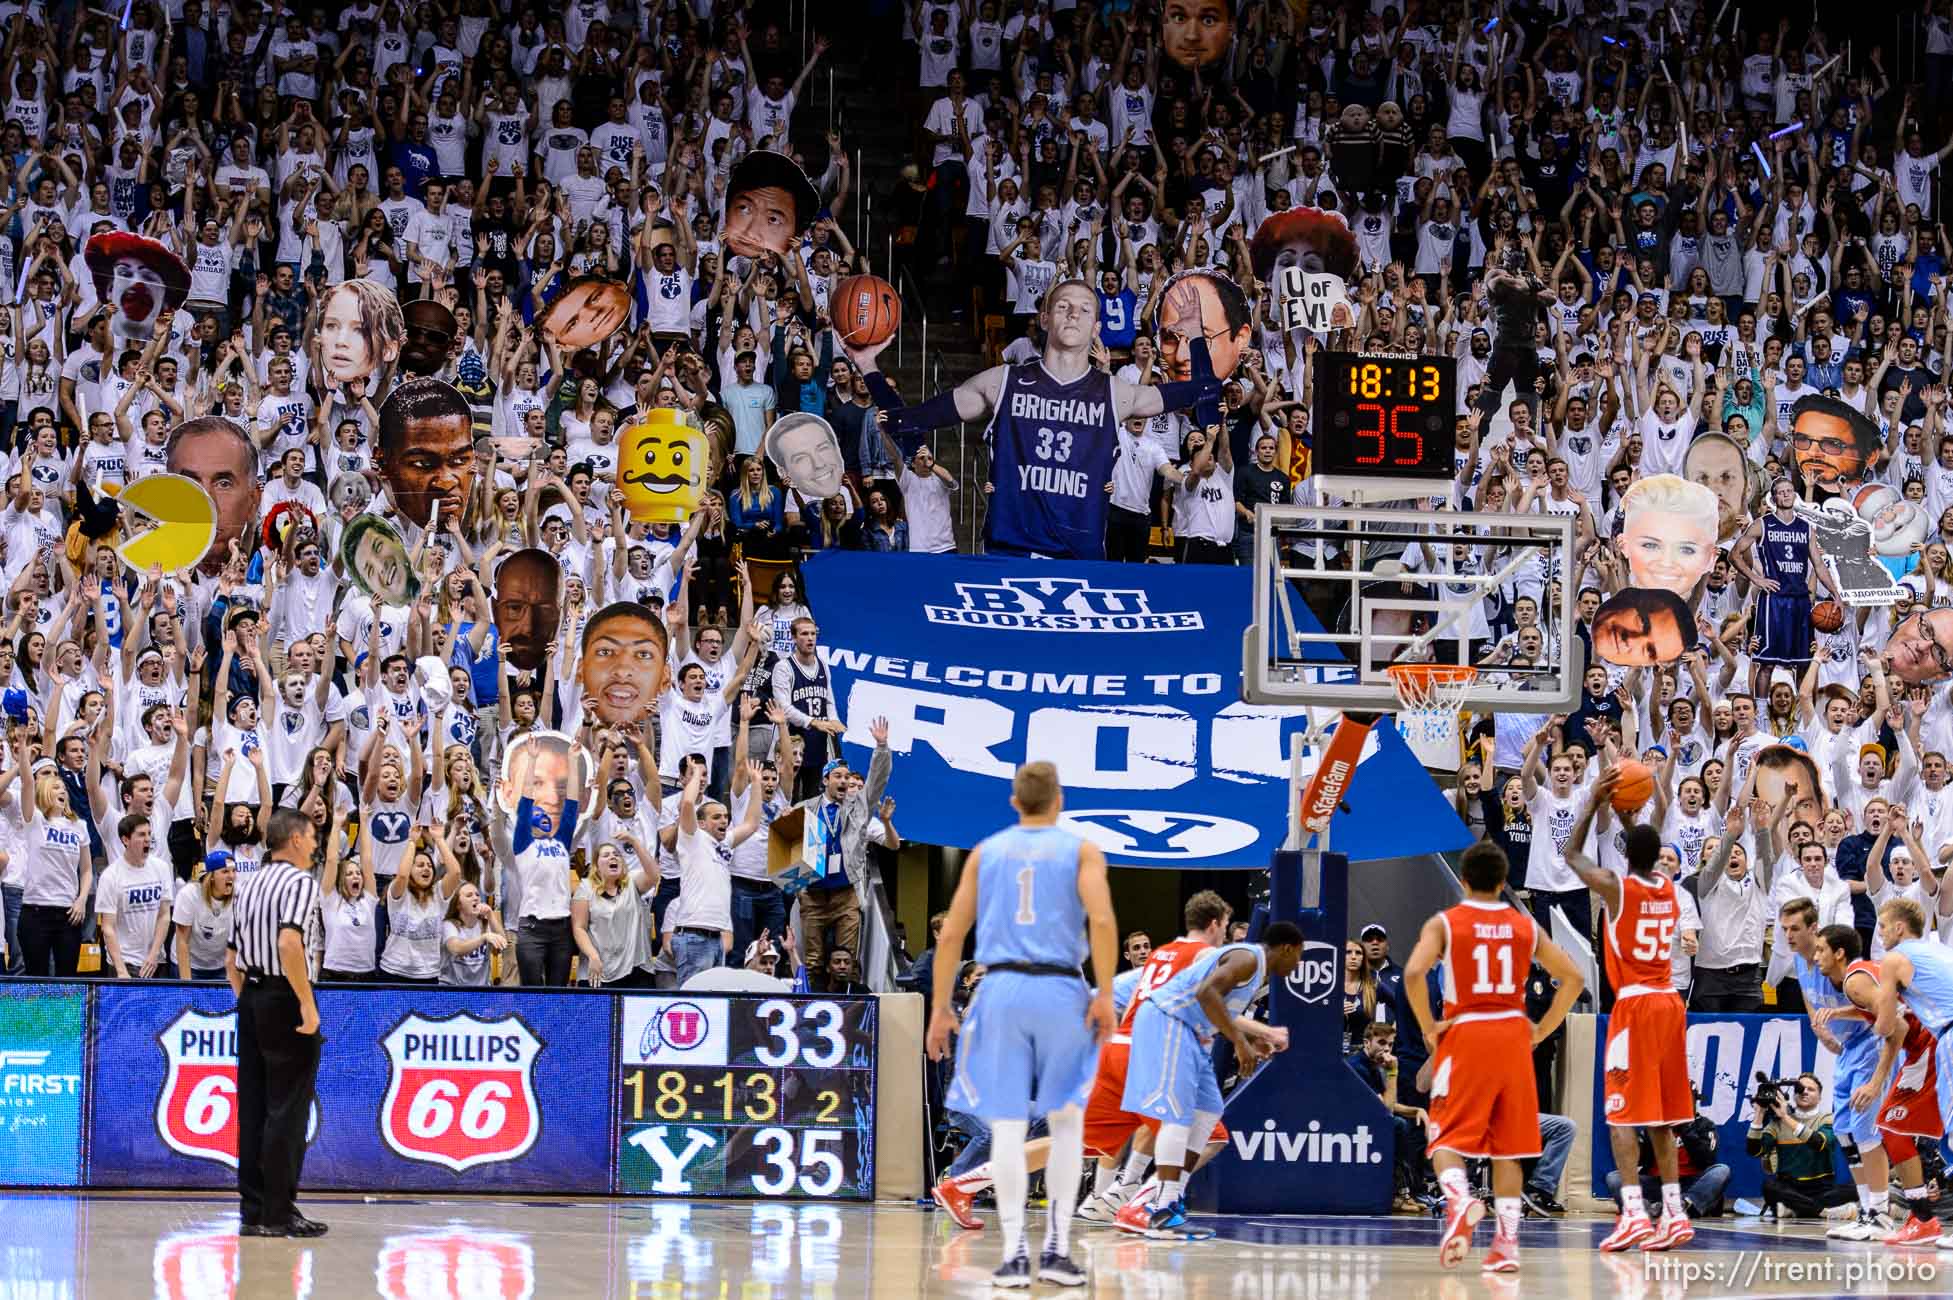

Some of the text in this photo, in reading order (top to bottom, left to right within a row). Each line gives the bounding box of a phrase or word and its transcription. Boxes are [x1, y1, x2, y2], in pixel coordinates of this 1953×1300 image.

[498, 120, 521, 132] RISE
[610, 135, 633, 147] RISE
[1286, 271, 1331, 297] U OF
[1106, 297, 1127, 331] 9
[1703, 331, 1728, 342] RISE
[1357, 351, 1418, 361] DAKTRONICS
[1351, 364, 1440, 401] 18:13
[1011, 393, 1105, 427] BRIGHAM
[1035, 427, 1074, 462] 33
[1356, 403, 1424, 465] 35
[34, 466, 58, 483] Y
[587, 455, 610, 468] Y
[1018, 464, 1089, 498] YOUNG
[1767, 530, 1807, 544] BRIGHAM
[1784, 545, 1793, 560] 3
[1776, 560, 1803, 573] YOUNG
[957, 577, 1150, 615] BYU
[930, 607, 1198, 630] BOOKSTORE
[815, 645, 1127, 696] WELCOME
[1143, 673, 1222, 695] TO
[806, 698, 821, 717] 13
[842, 678, 1381, 790] ROC
[46, 827, 80, 846] ROC
[376, 814, 407, 841] Y
[1070, 814, 1216, 853] Y
[128, 886, 162, 904] ROC
[1014, 866, 1035, 925] 1
[1633, 919, 1674, 961] 55
[1290, 959, 1334, 993] ups
[1473, 944, 1516, 994] 11
[181, 1030, 237, 1057] PHIL
[405, 1034, 521, 1062] PHILLIPS
[667, 1000, 847, 1067] U 33
[5, 1074, 80, 1095] FIRST
[624, 1070, 841, 1122] 18:13 2
[184, 1075, 237, 1135] 6
[407, 1079, 512, 1140] 66
[1231, 1119, 1382, 1164] vivint.
[628, 1126, 845, 1196] Y 35
